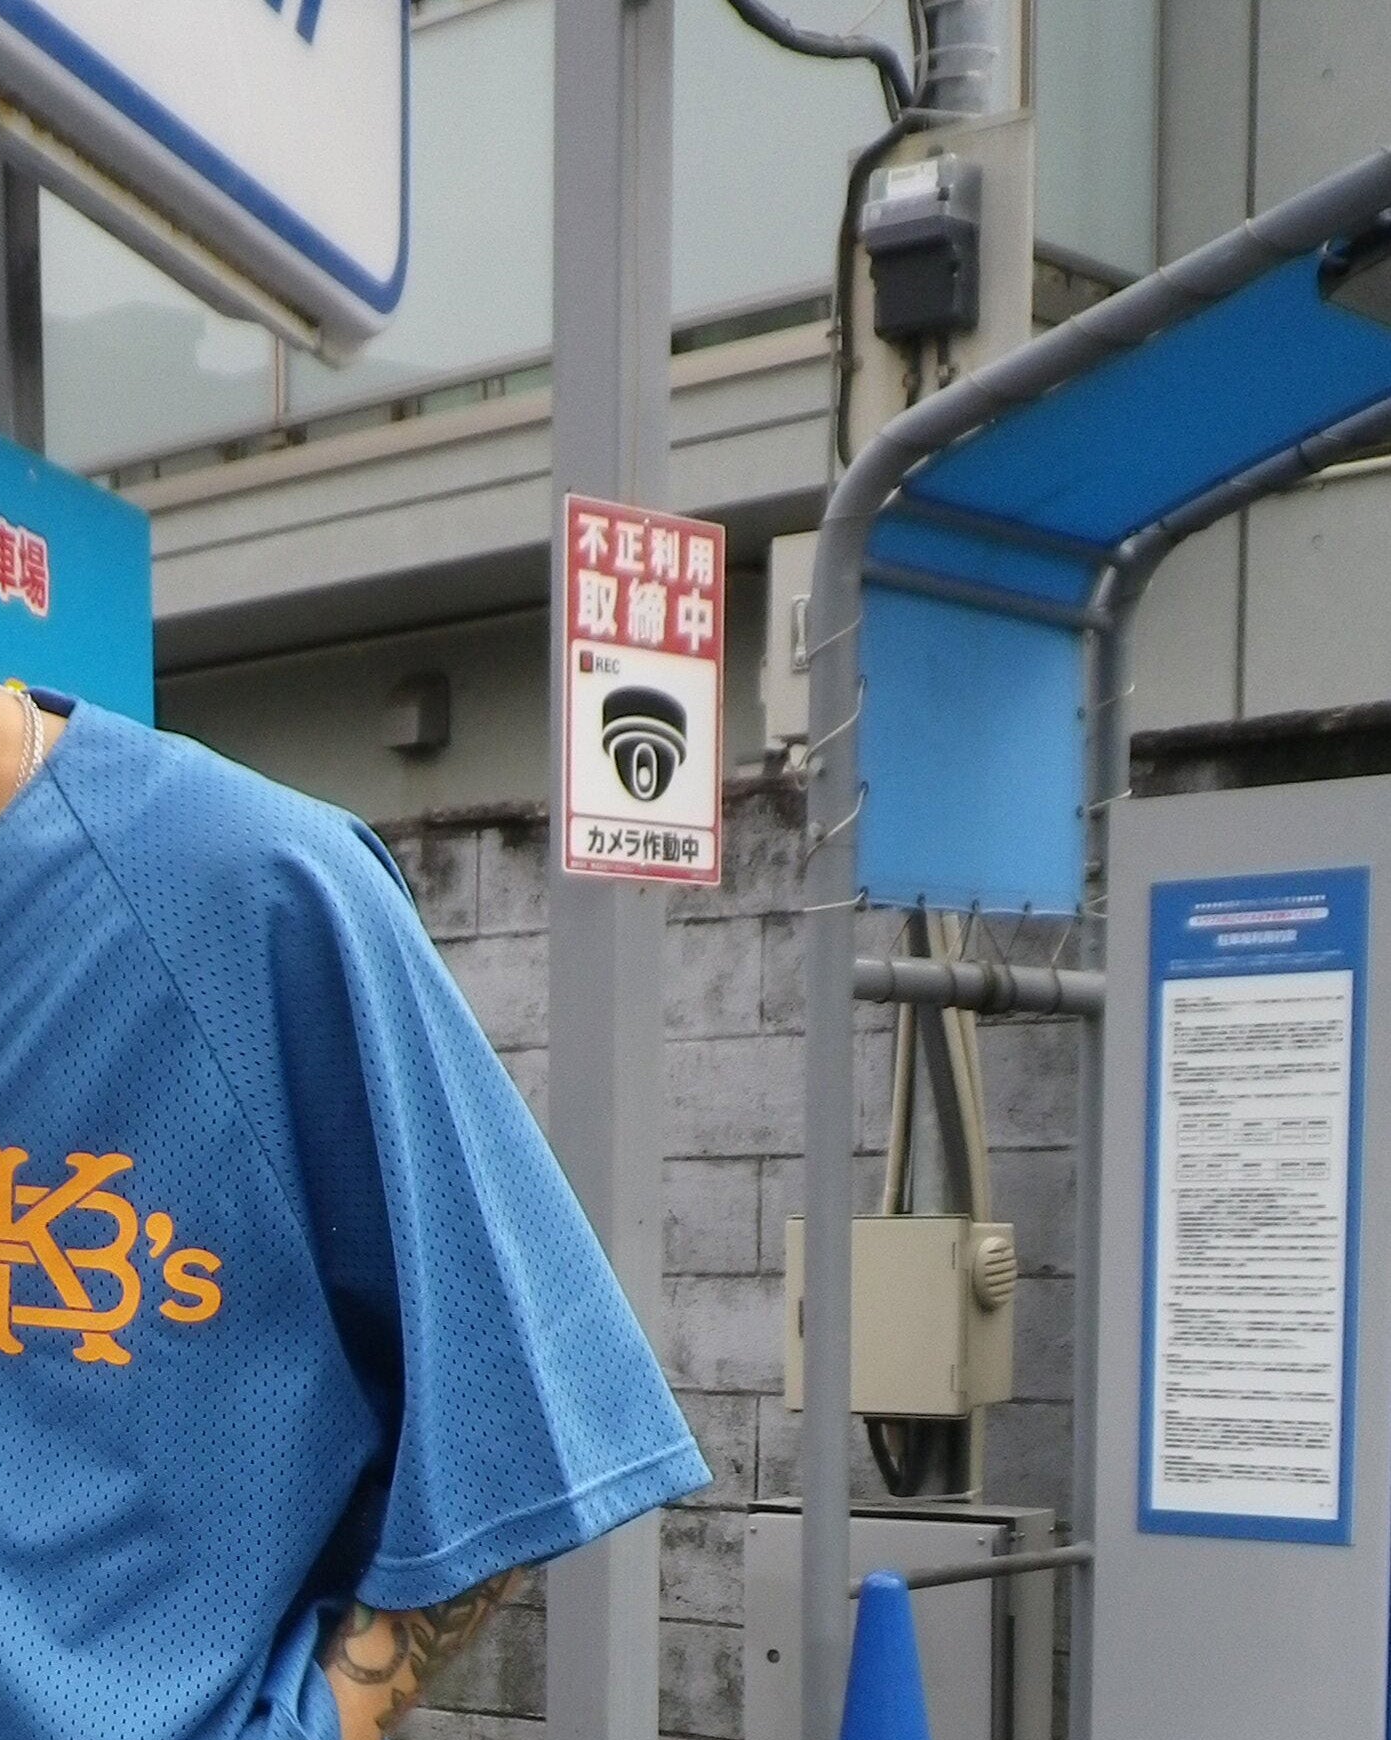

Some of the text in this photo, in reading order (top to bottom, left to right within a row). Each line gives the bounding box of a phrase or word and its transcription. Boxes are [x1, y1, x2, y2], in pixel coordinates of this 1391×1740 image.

[577, 512, 715, 588] 不正利用
[577, 568, 714, 653] 取締中
[595, 656, 620, 676] REC
[587, 825, 700, 863] カメラ作動中
